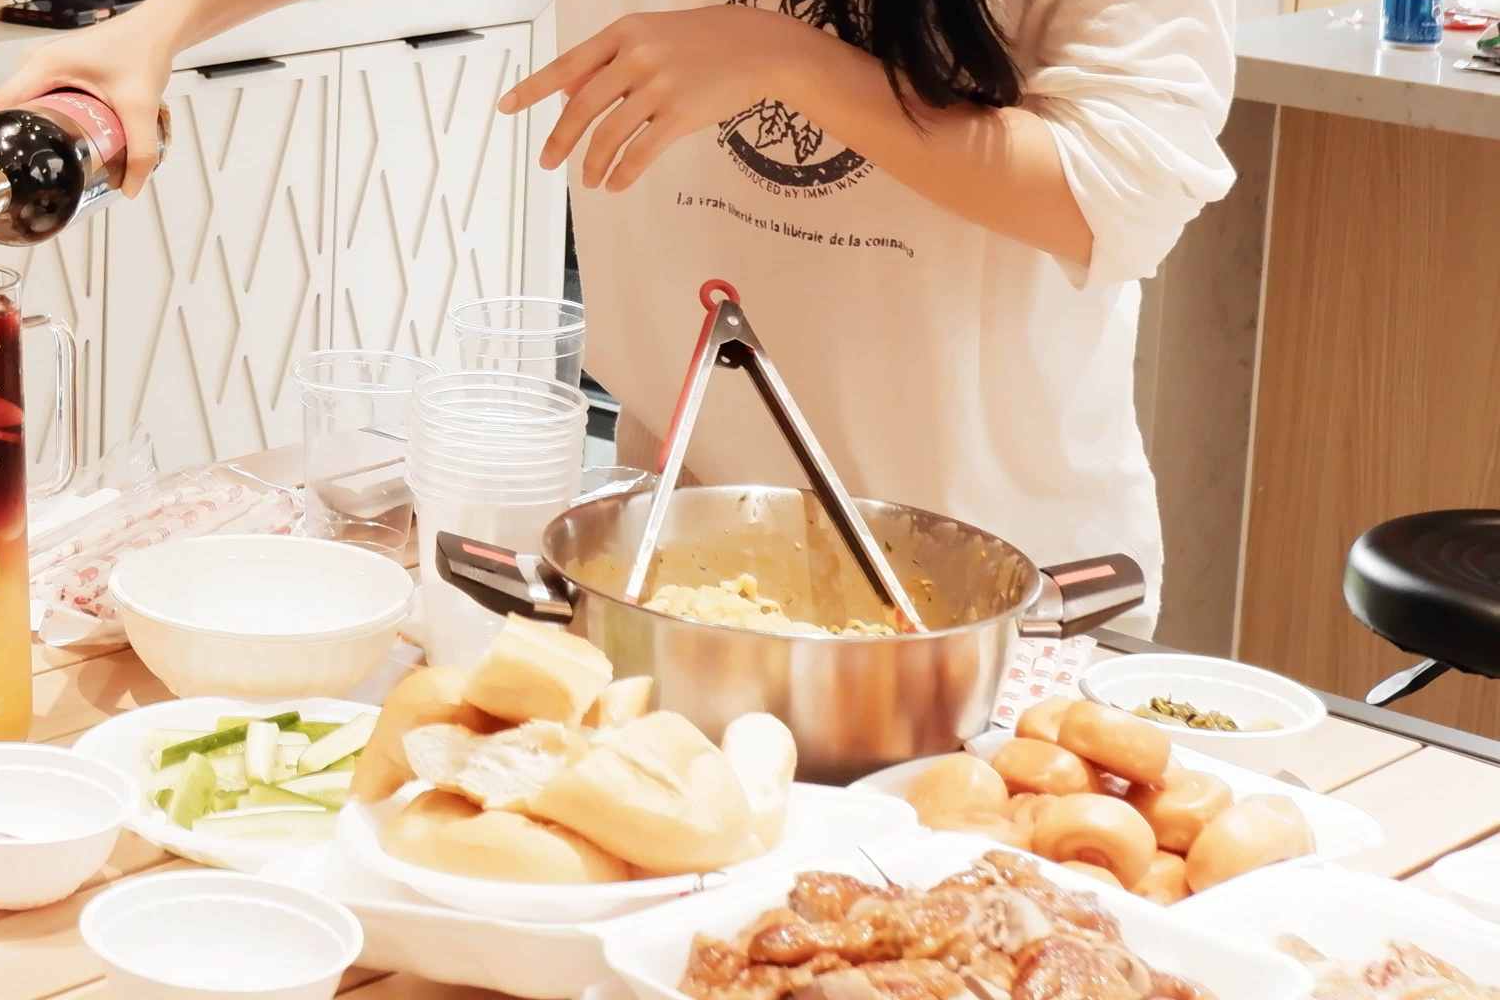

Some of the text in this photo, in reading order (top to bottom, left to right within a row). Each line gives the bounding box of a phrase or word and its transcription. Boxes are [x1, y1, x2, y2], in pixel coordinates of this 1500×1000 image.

[784, 188, 800, 200] BY
[770, 220, 780, 233] la
[829, 232, 845, 247] de
[848, 233, 861, 248] la
